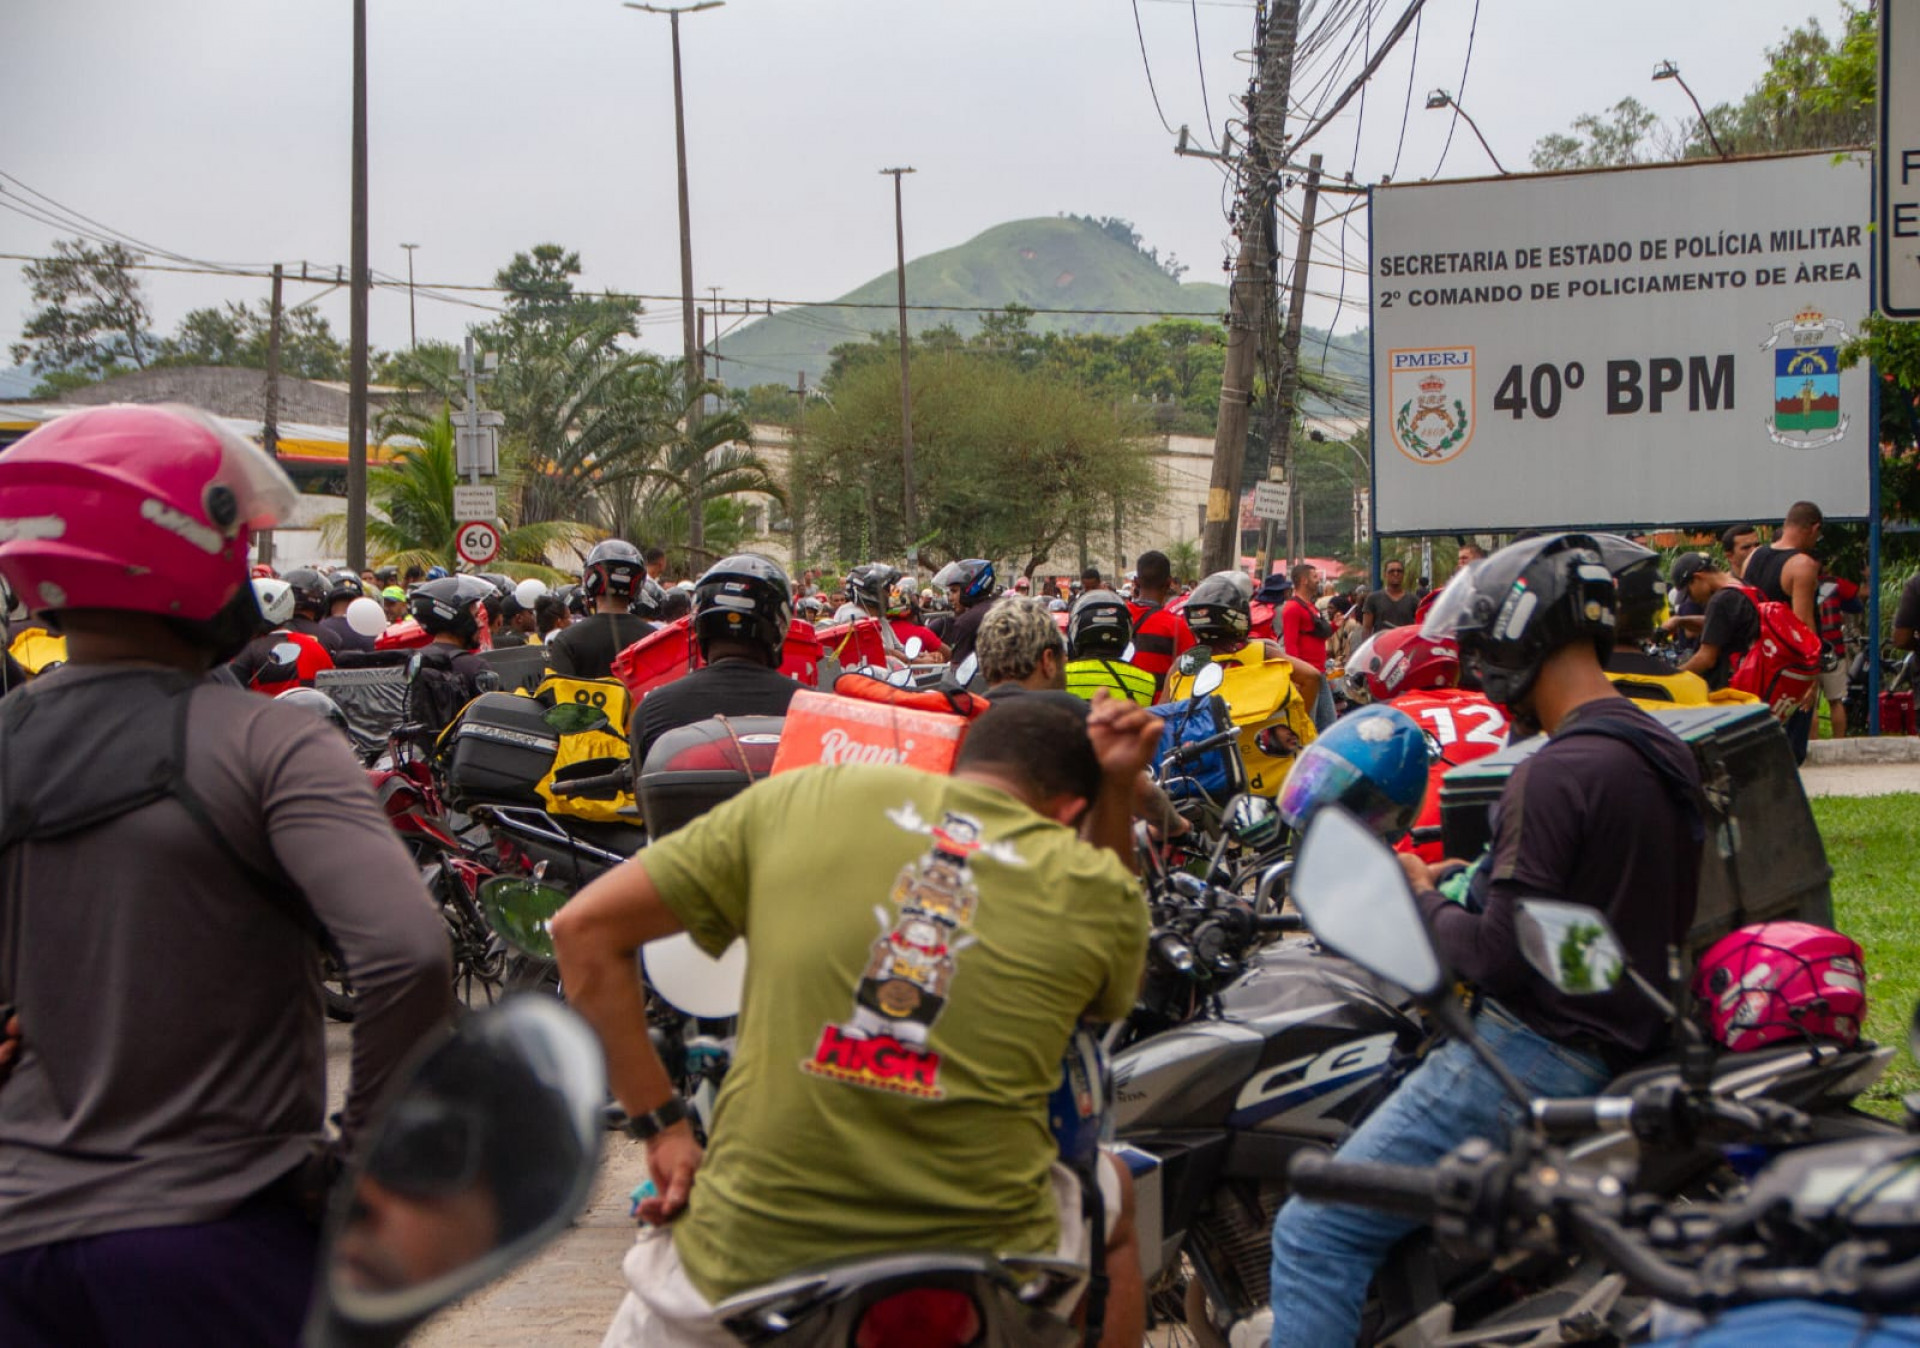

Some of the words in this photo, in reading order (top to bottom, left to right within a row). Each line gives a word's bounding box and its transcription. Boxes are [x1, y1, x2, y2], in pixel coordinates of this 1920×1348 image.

[1380, 250, 1508, 277] SECRETARIA
[1515, 248, 1542, 270] DE
[1549, 241, 1632, 267] ESTADO
[1639, 238, 1668, 261] DE
[1674, 230, 1763, 259] POLÍCIA
[1770, 225, 1862, 252] MILITAR
[1408, 284, 1523, 307] COMANDO
[1530, 282, 1560, 301] DE
[1568, 270, 1747, 298] POLICIAMENTO
[1755, 267, 1786, 286] DE
[1394, 351, 1469, 368] PMERJ
[1493, 361, 1585, 420] 40º
[1606, 354, 1735, 415] BPM
[465, 531, 493, 549] 60
[1420, 703, 1511, 748] 12
[815, 1024, 940, 1087] HIGH
